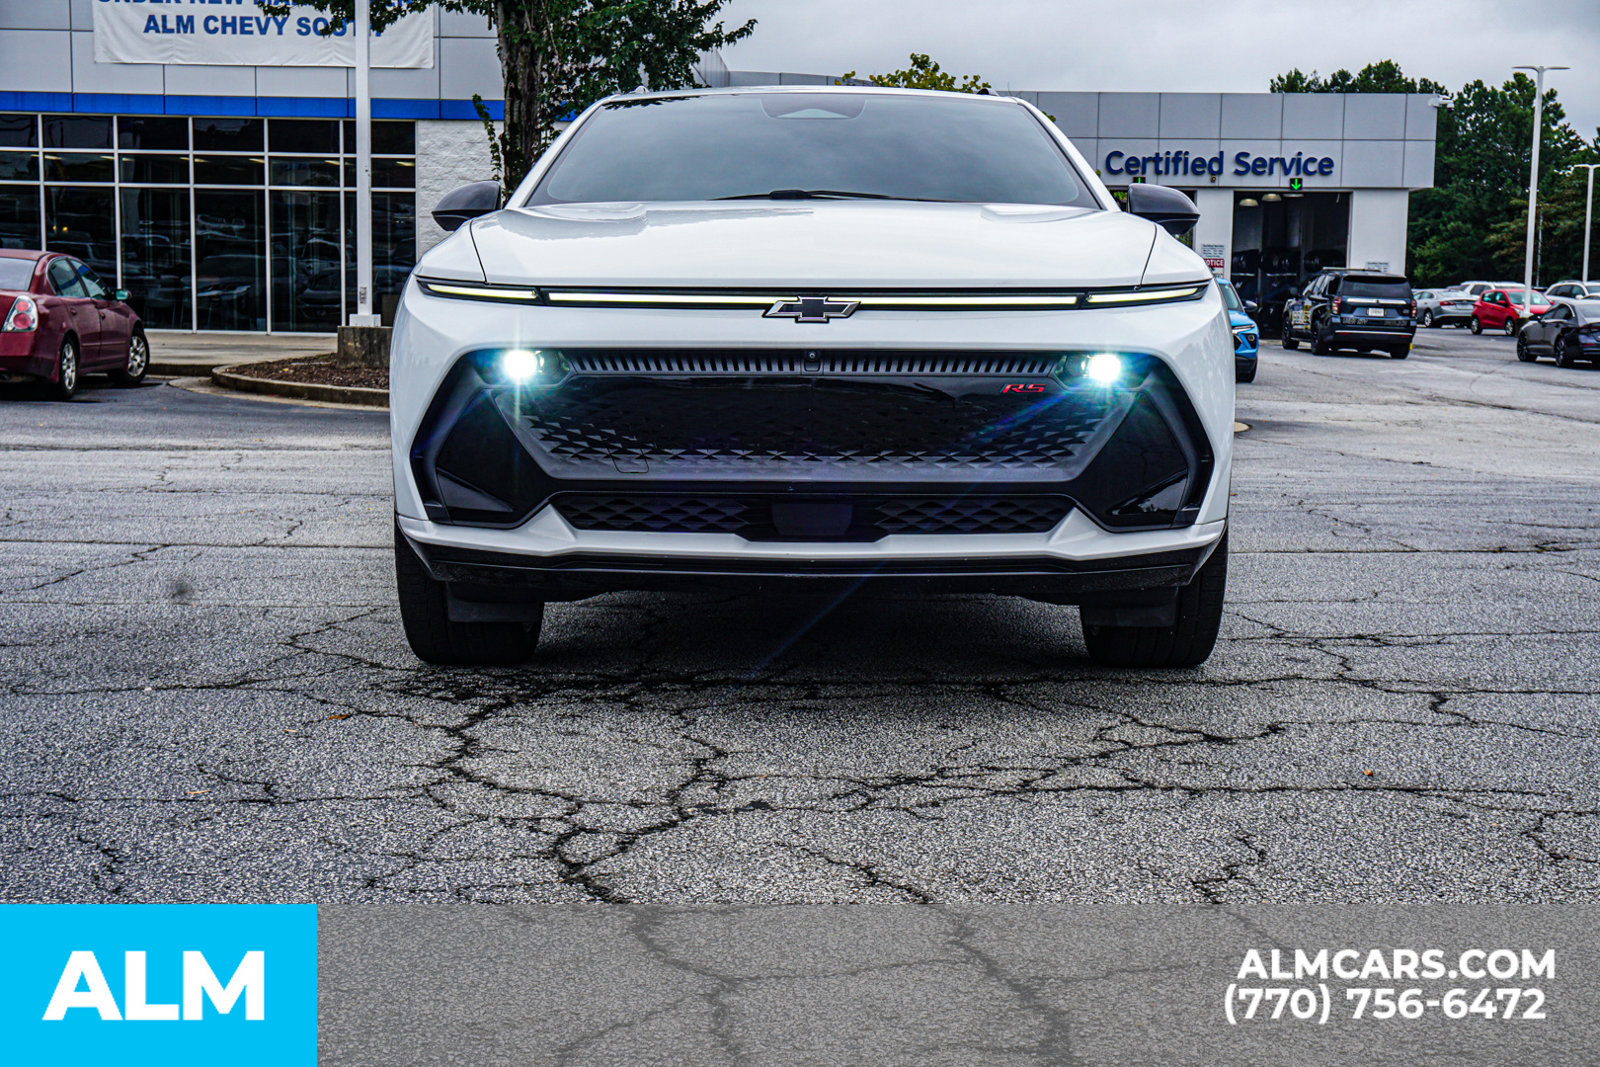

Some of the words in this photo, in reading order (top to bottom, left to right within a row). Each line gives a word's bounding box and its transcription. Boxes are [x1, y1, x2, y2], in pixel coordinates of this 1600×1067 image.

[143, 14, 196, 34] ALM
[203, 15, 288, 36] CHEVY
[296, 16, 382, 37] SOU
[1105, 150, 1224, 176] Certified
[1233, 151, 1335, 177] Service
[1204, 259, 1224, 267] OTICE
[1001, 383, 1047, 393] RS
